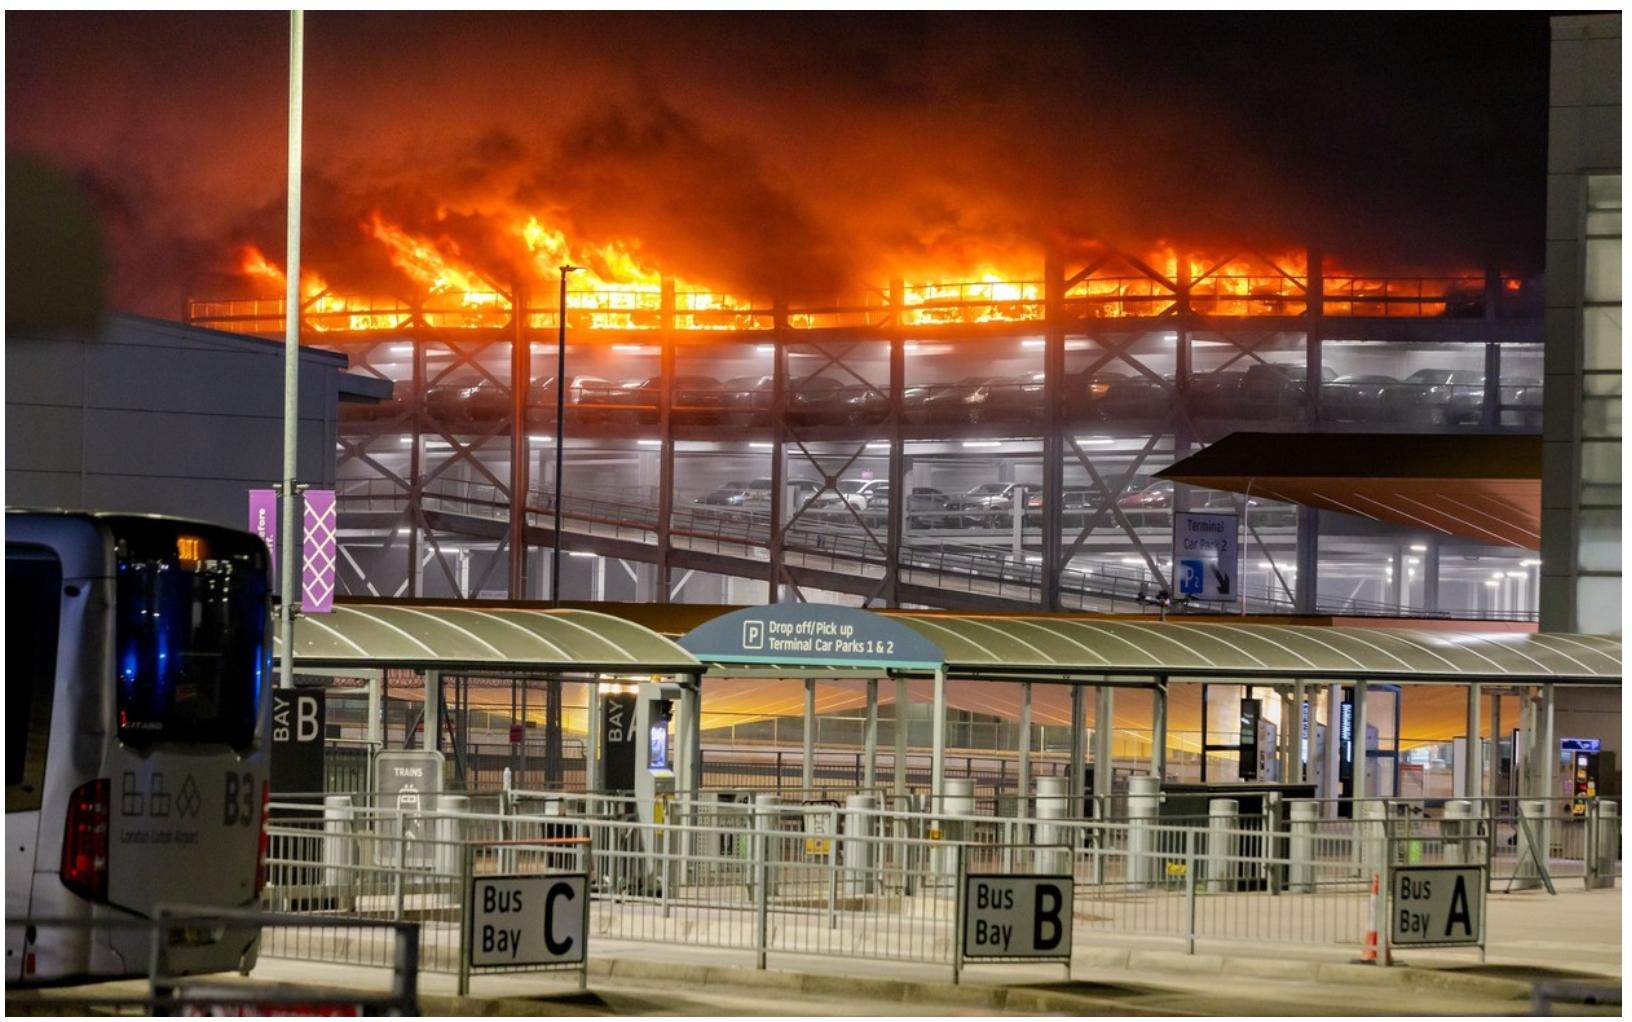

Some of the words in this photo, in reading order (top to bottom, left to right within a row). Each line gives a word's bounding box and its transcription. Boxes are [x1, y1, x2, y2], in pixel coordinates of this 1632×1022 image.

[1188, 519, 1224, 533] Terminal
[1184, 537, 1199, 550] Car
[1221, 540, 1228, 552] 2
[769, 621, 793, 636] Drop
[796, 621, 837, 636] off/Pick
[840, 625, 854, 638] up
[768, 638, 812, 651] Terminal
[815, 639, 832, 652] Car
[836, 640, 865, 653] Parks
[867, 641, 873, 653] 1
[876, 641, 884, 654] &
[886, 641, 894, 654] 2
[273, 697, 290, 742] BAY
[297, 696, 318, 742] B
[608, 700, 623, 742] BAY
[394, 767, 423, 777] TRAINS
[224, 771, 255, 827] B3
[483, 885, 522, 913] Bus
[977, 884, 1013, 910] Bus
[1401, 876, 1431, 900] Bus
[544, 882, 575, 956] C
[1033, 884, 1063, 950] B
[1444, 875, 1472, 936] A
[976, 919, 1012, 953] Bay
[1400, 909, 1430, 939] Bay
[482, 924, 522, 960] Bay
